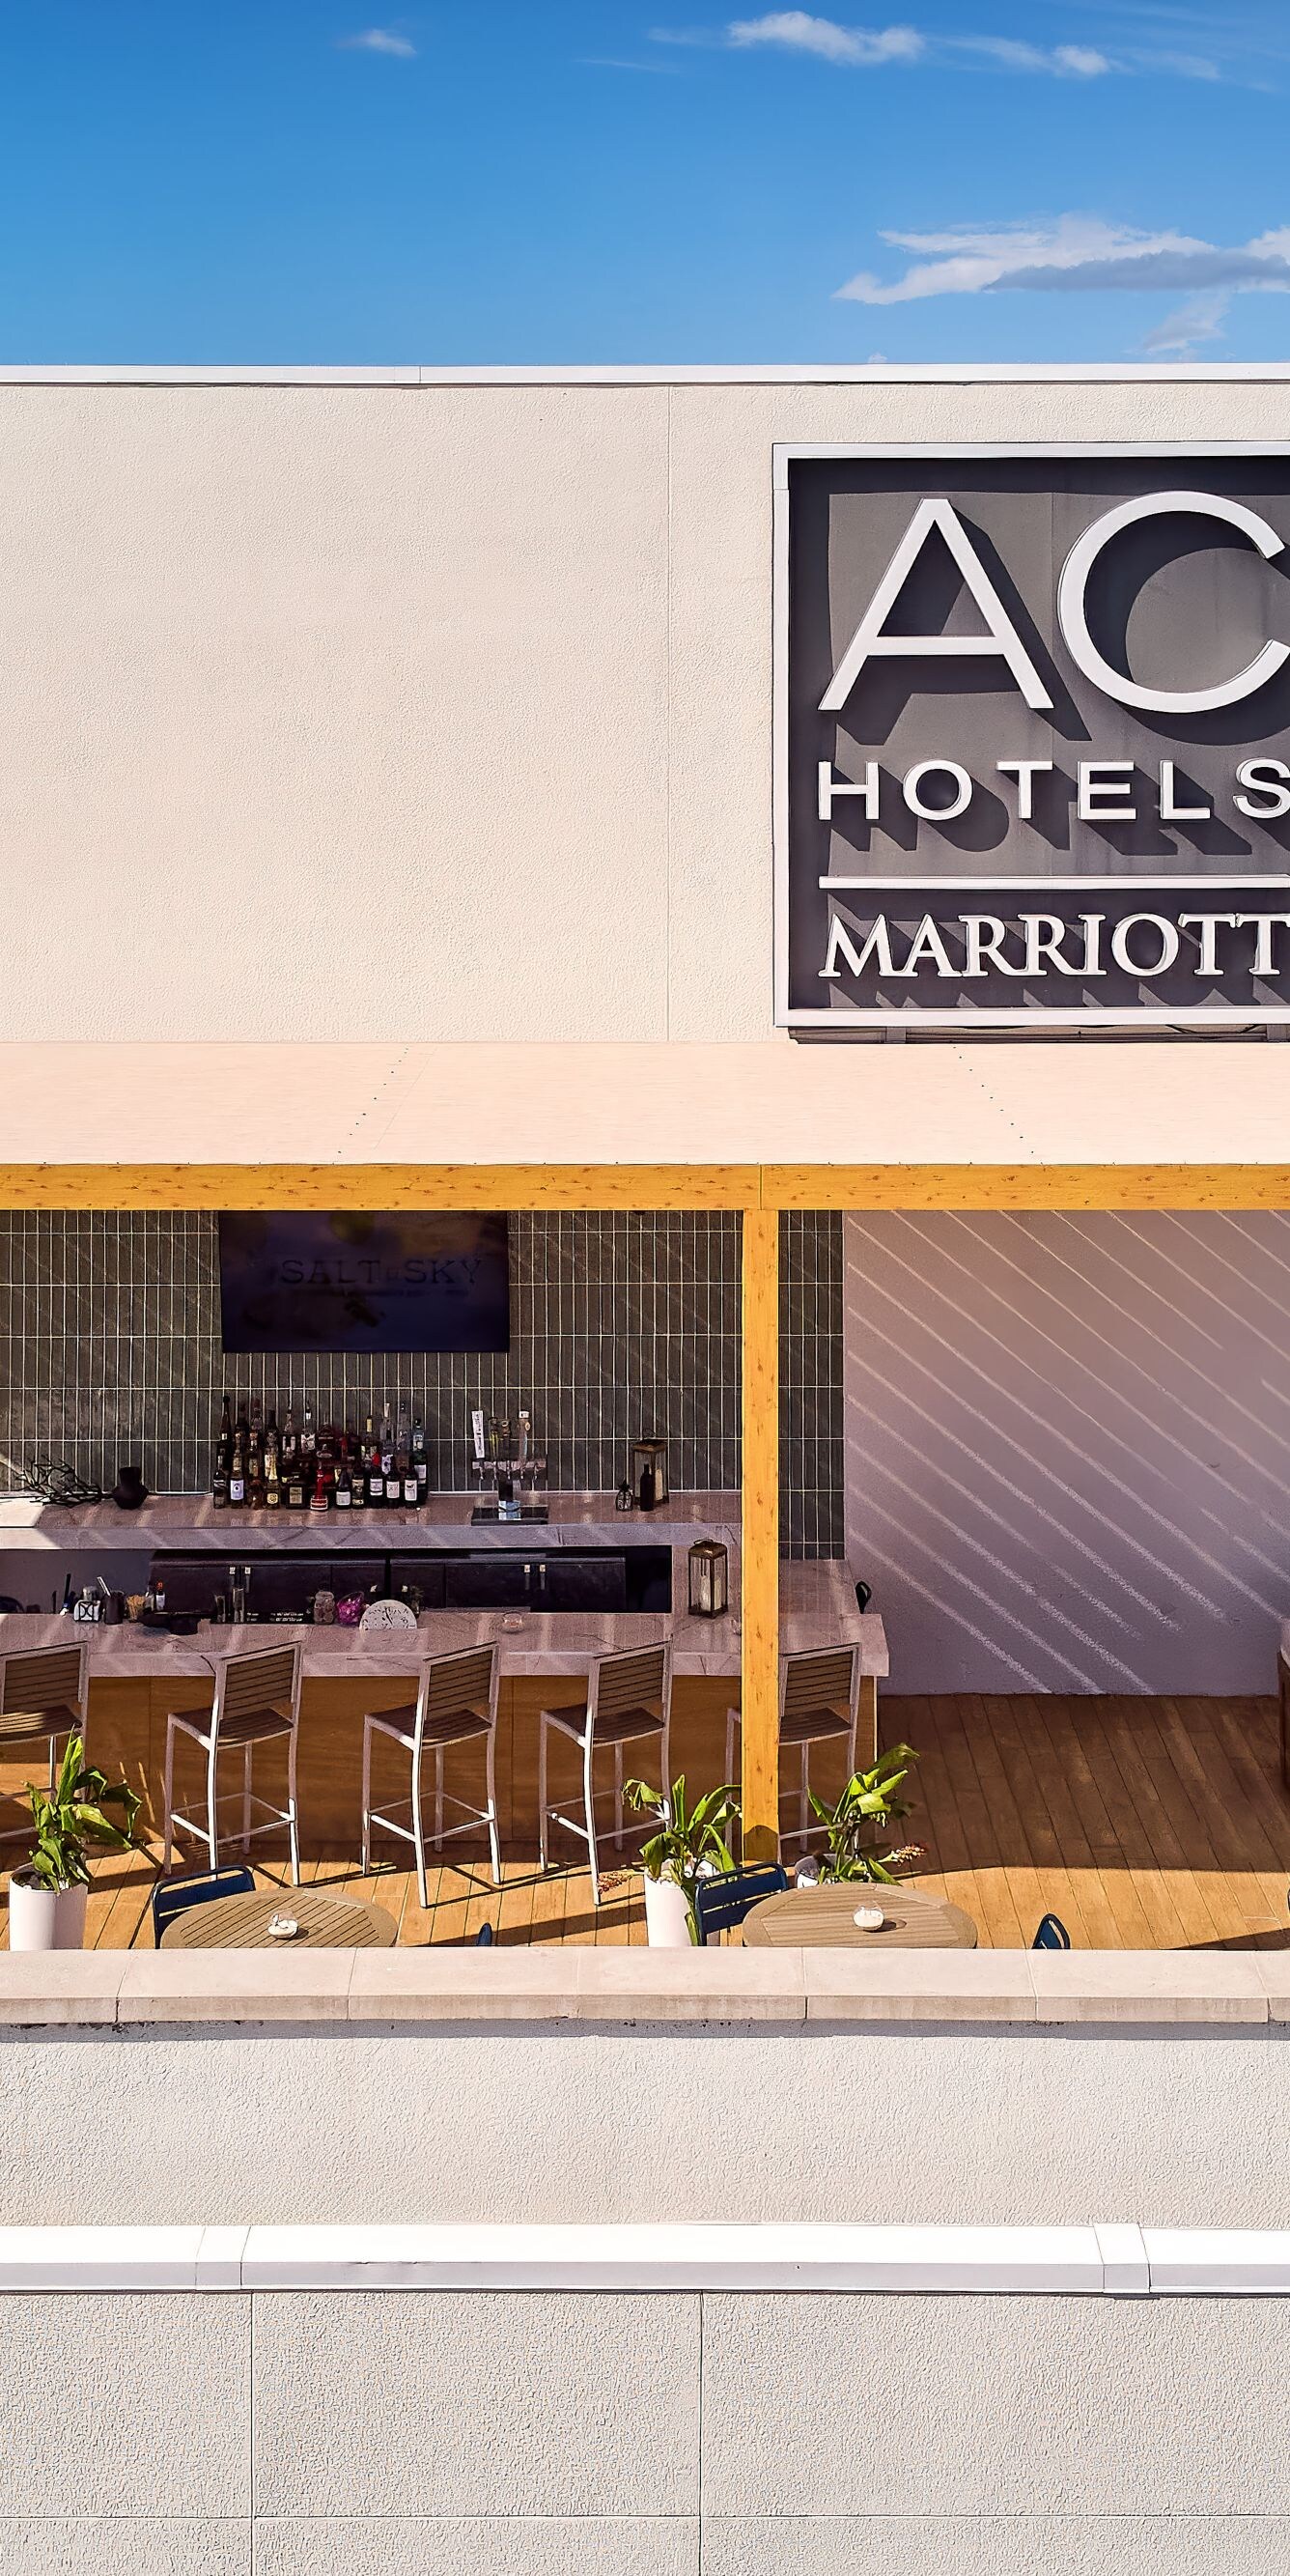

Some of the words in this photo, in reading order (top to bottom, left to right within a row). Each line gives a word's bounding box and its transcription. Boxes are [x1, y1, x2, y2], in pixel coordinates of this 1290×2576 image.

[818, 490, 1290, 714] AC
[818, 758, 1290, 821] HOTELS
[818, 912, 1290, 978] MARRIOTT
[280, 1260, 381, 1285] SALT
[404, 1259, 481, 1285] SKY
